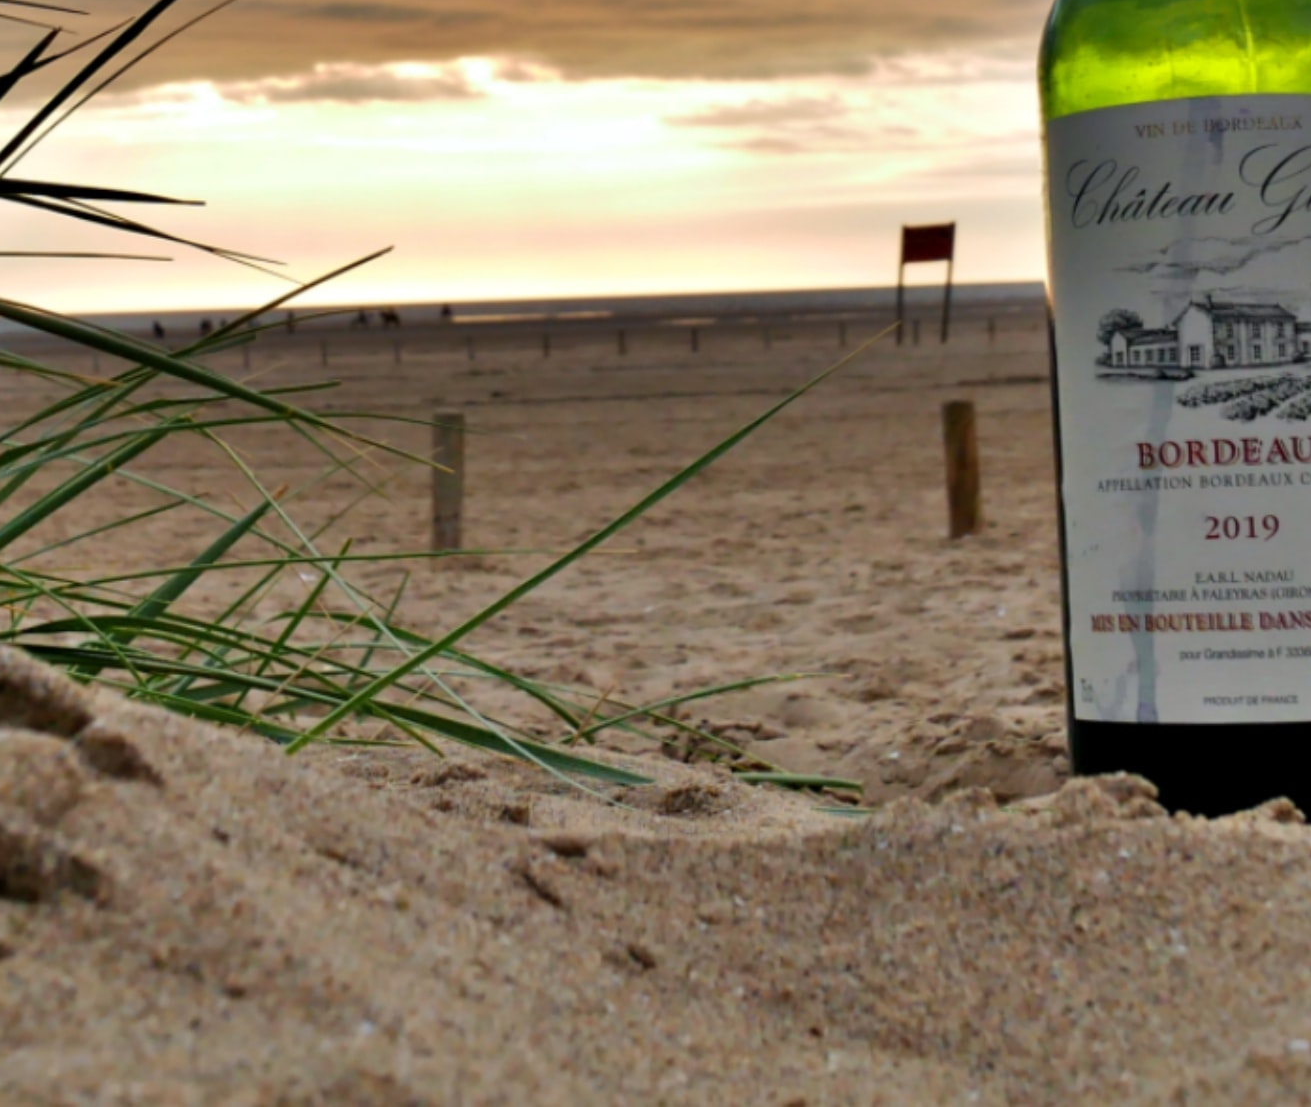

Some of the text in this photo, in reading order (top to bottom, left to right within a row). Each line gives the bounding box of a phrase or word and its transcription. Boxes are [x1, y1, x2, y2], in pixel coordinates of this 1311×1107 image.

[1134, 114, 1303, 138] VIN DE BORDEAUX
[1066, 158, 1237, 228] Château
[1097, 475, 1192, 492] APPELLATION
[1199, 471, 1294, 489] BORDEAUX
[1204, 514, 1280, 540] 2019
[1091, 614, 1114, 632] MIS
[1118, 613, 1140, 632] EN
[1144, 612, 1254, 632] BOUTEILLE
